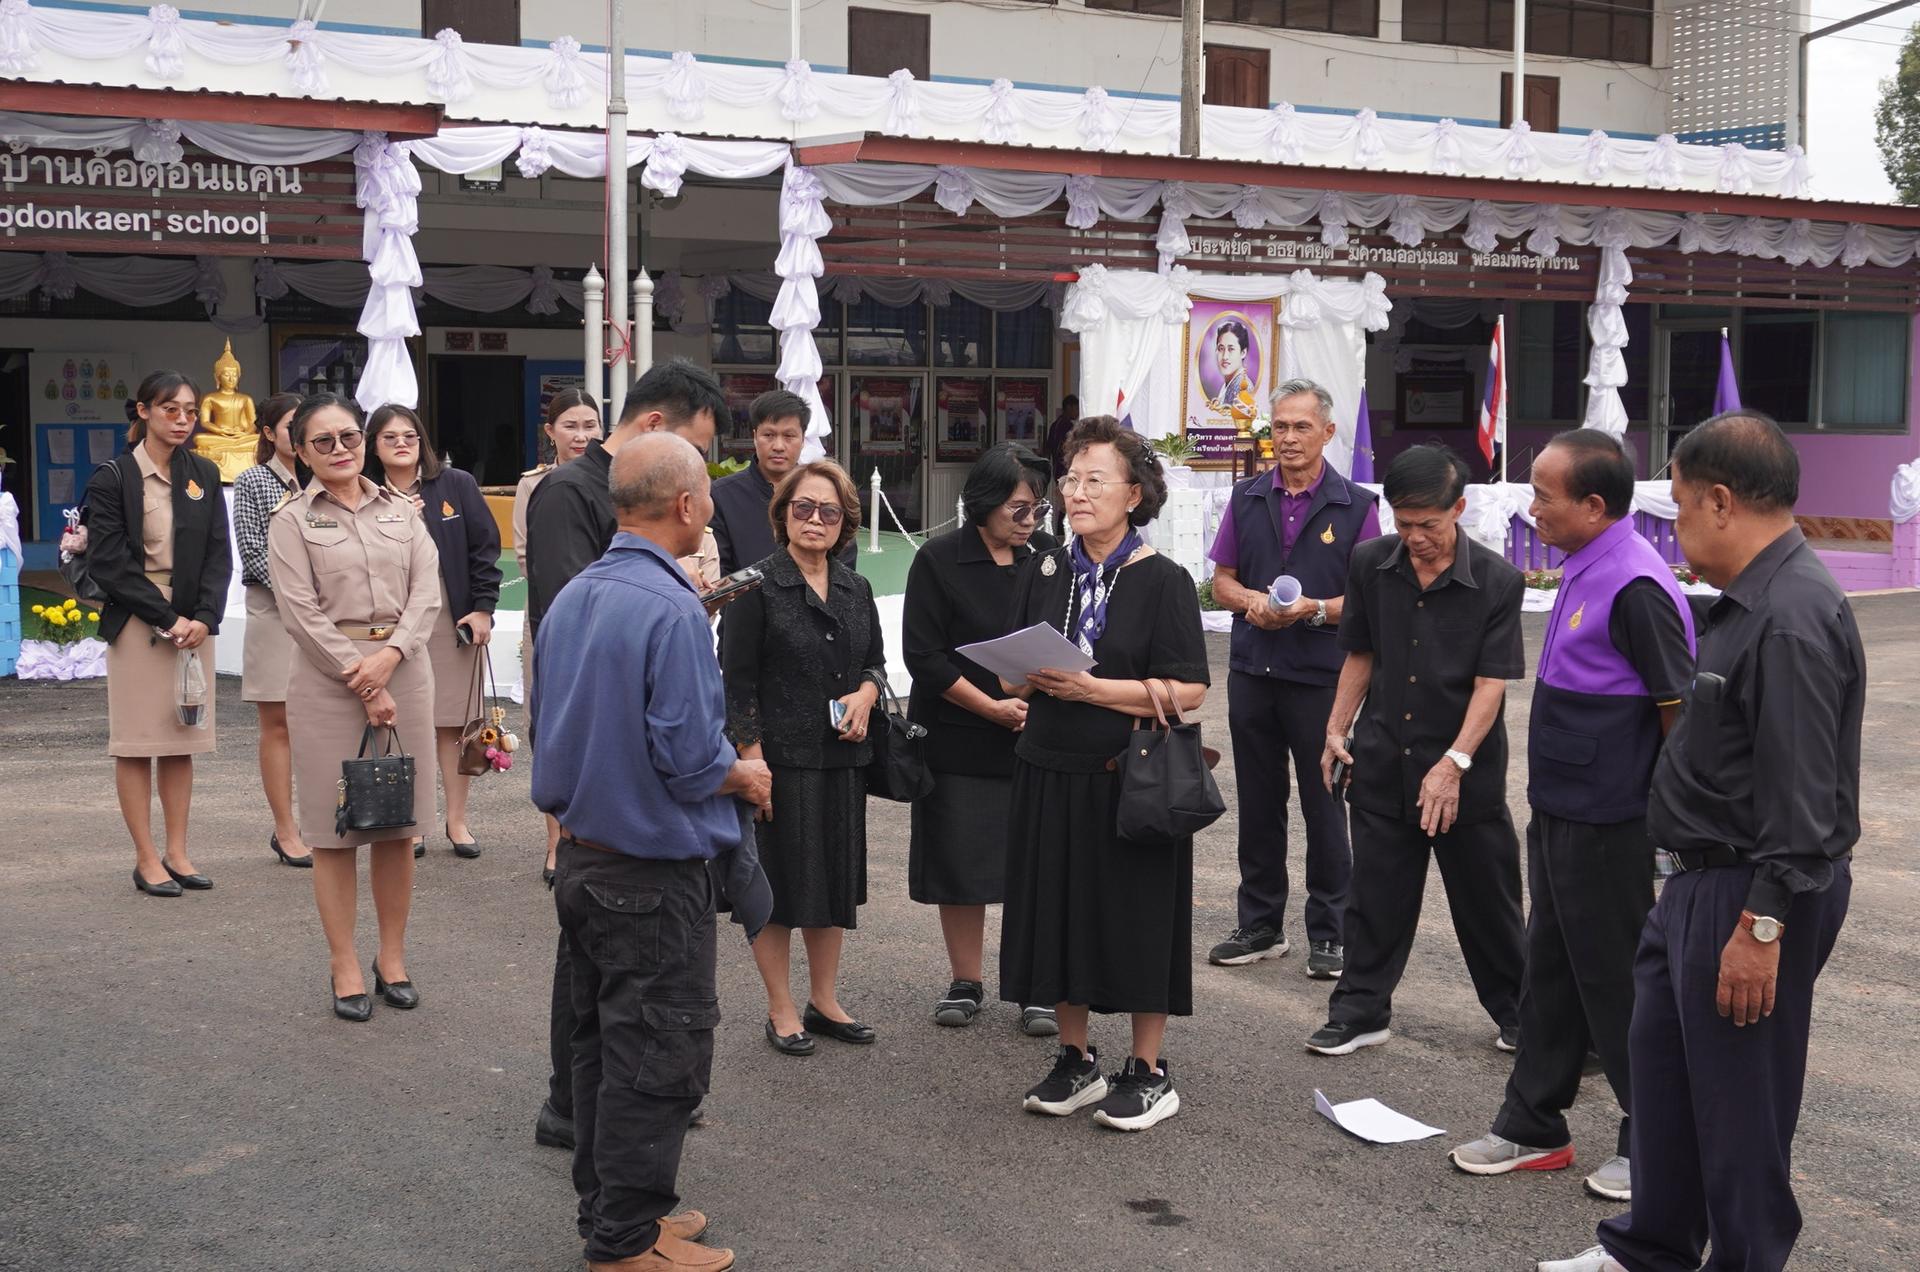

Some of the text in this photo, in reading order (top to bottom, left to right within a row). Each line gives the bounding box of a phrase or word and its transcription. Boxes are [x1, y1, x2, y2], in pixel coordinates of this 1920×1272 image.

[167, 209, 267, 235] school
[1190, 232, 1251, 256] ประหยัด
[1348, 237, 1458, 265] มีความออนน้อม
